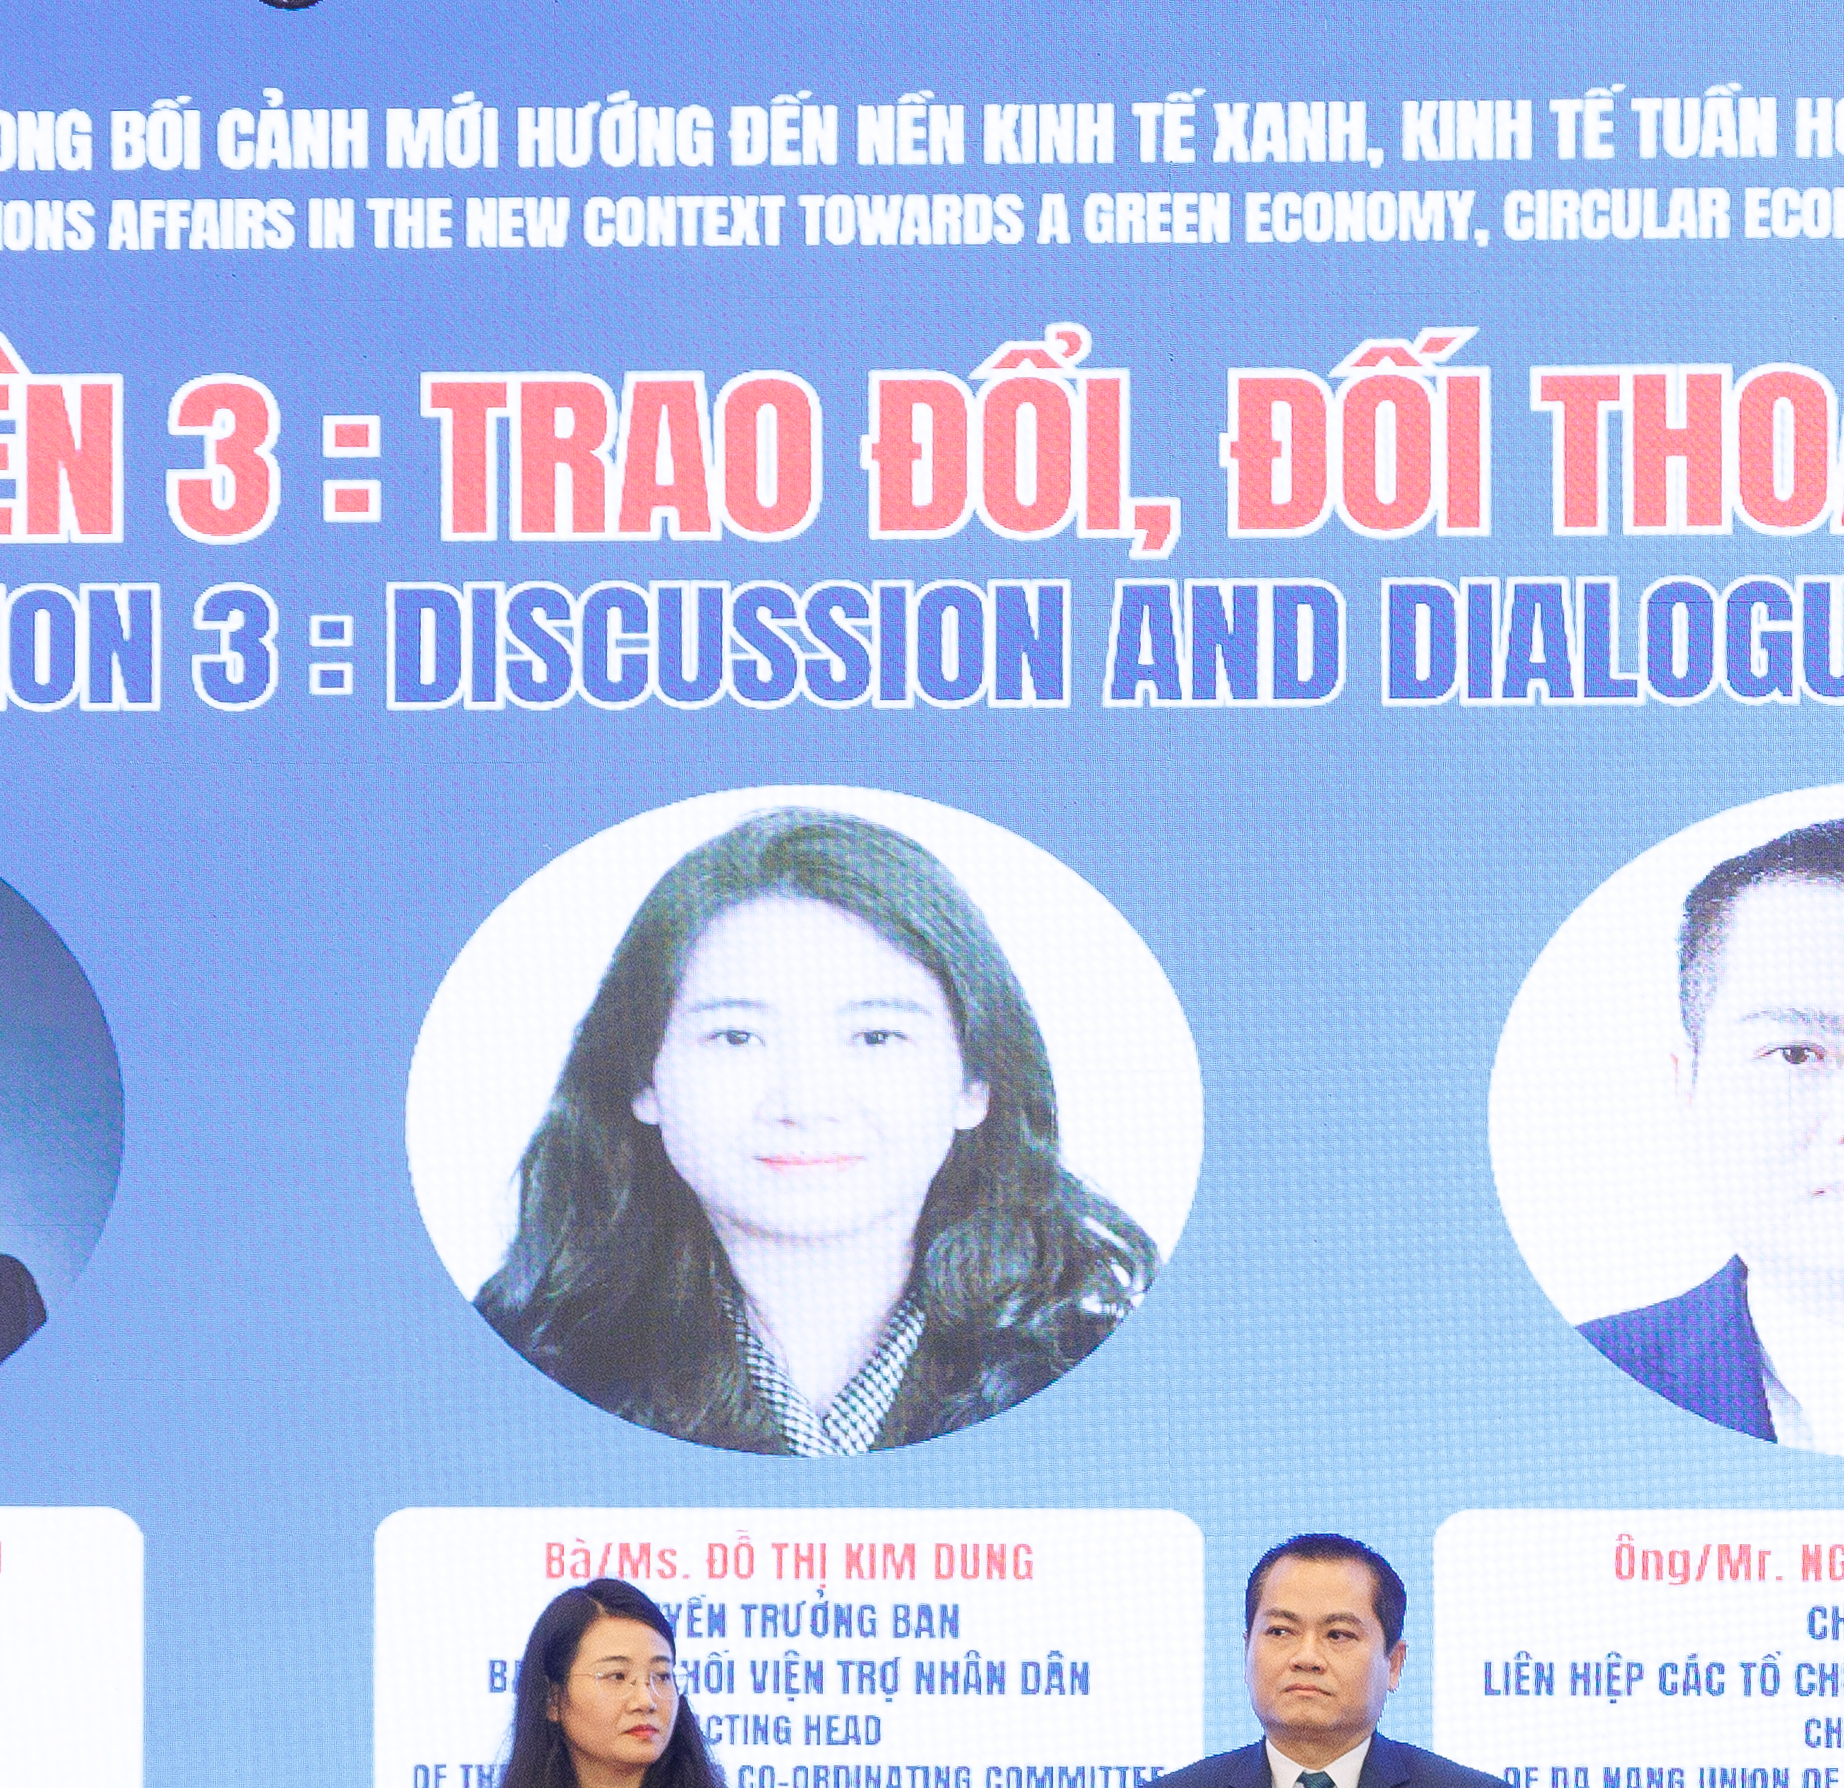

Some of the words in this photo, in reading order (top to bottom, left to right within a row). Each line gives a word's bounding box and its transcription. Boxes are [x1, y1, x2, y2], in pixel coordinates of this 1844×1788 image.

[111, 95, 201, 171] BỐI
[217, 87, 369, 170] CẢNH
[386, 91, 499, 169] MỚI
[517, 90, 714, 169] HƯỚNG
[728, 90, 838, 167] ĐẾN
[983, 102, 1115, 165] KINH
[1131, 88, 1203, 164] TẾ
[1212, 100, 1384, 168] XANH,
[1402, 99, 1533, 161] KINH
[1549, 83, 1623, 160] TẾ
[108, 198, 295, 251] AFFAIRS
[308, 198, 355, 249] IN
[366, 197, 452, 249] THE
[466, 196, 570, 248] NEW
[584, 194, 786, 248] CONTEXT
[798, 193, 1025, 246] TOWARDS
[1037, 193, 1071, 245] A
[1083, 191, 1231, 244] GREEN
[1245, 189, 1489, 247] ECONOMY,
[1503, 186, 1731, 241] CIRCULAR
[166, 373, 281, 545] 3
[420, 370, 823, 542] TRAO
[860, 322, 1181, 560] ĐỔI,
[1219, 326, 1491, 540] ĐỐI
[192, 582, 279, 712] 3
[386, 579, 1071, 711] DISCUSSION
[1103, 578, 1346, 708] AND
[545, 1536, 691, 1581] Bà/Ms.
[705, 1529, 756, 1581] ĐỖ
[770, 1541, 828, 1590] THỊ
[844, 1542, 917, 1581] KIM
[933, 1542, 1034, 1581] DUNG
[1614, 1532, 1783, 1587] Ông/Mr.
[738, 1587, 879, 1640] TRƯỞNG
[891, 1602, 961, 1641] BAN
[748, 1648, 825, 1704] VIỆN
[835, 1655, 902, 1704] TRỢ
[913, 1648, 1007, 1697] NHÂN
[1019, 1649, 1091, 1697] DÂN
[1483, 1649, 1556, 1698] LIÊN
[1568, 1650, 1646, 1706] HIỆP
[1657, 1652, 1727, 1698] CÁC
[1737, 1649, 1783, 1698] TỔ
[803, 1713, 883, 1747] HEAD
